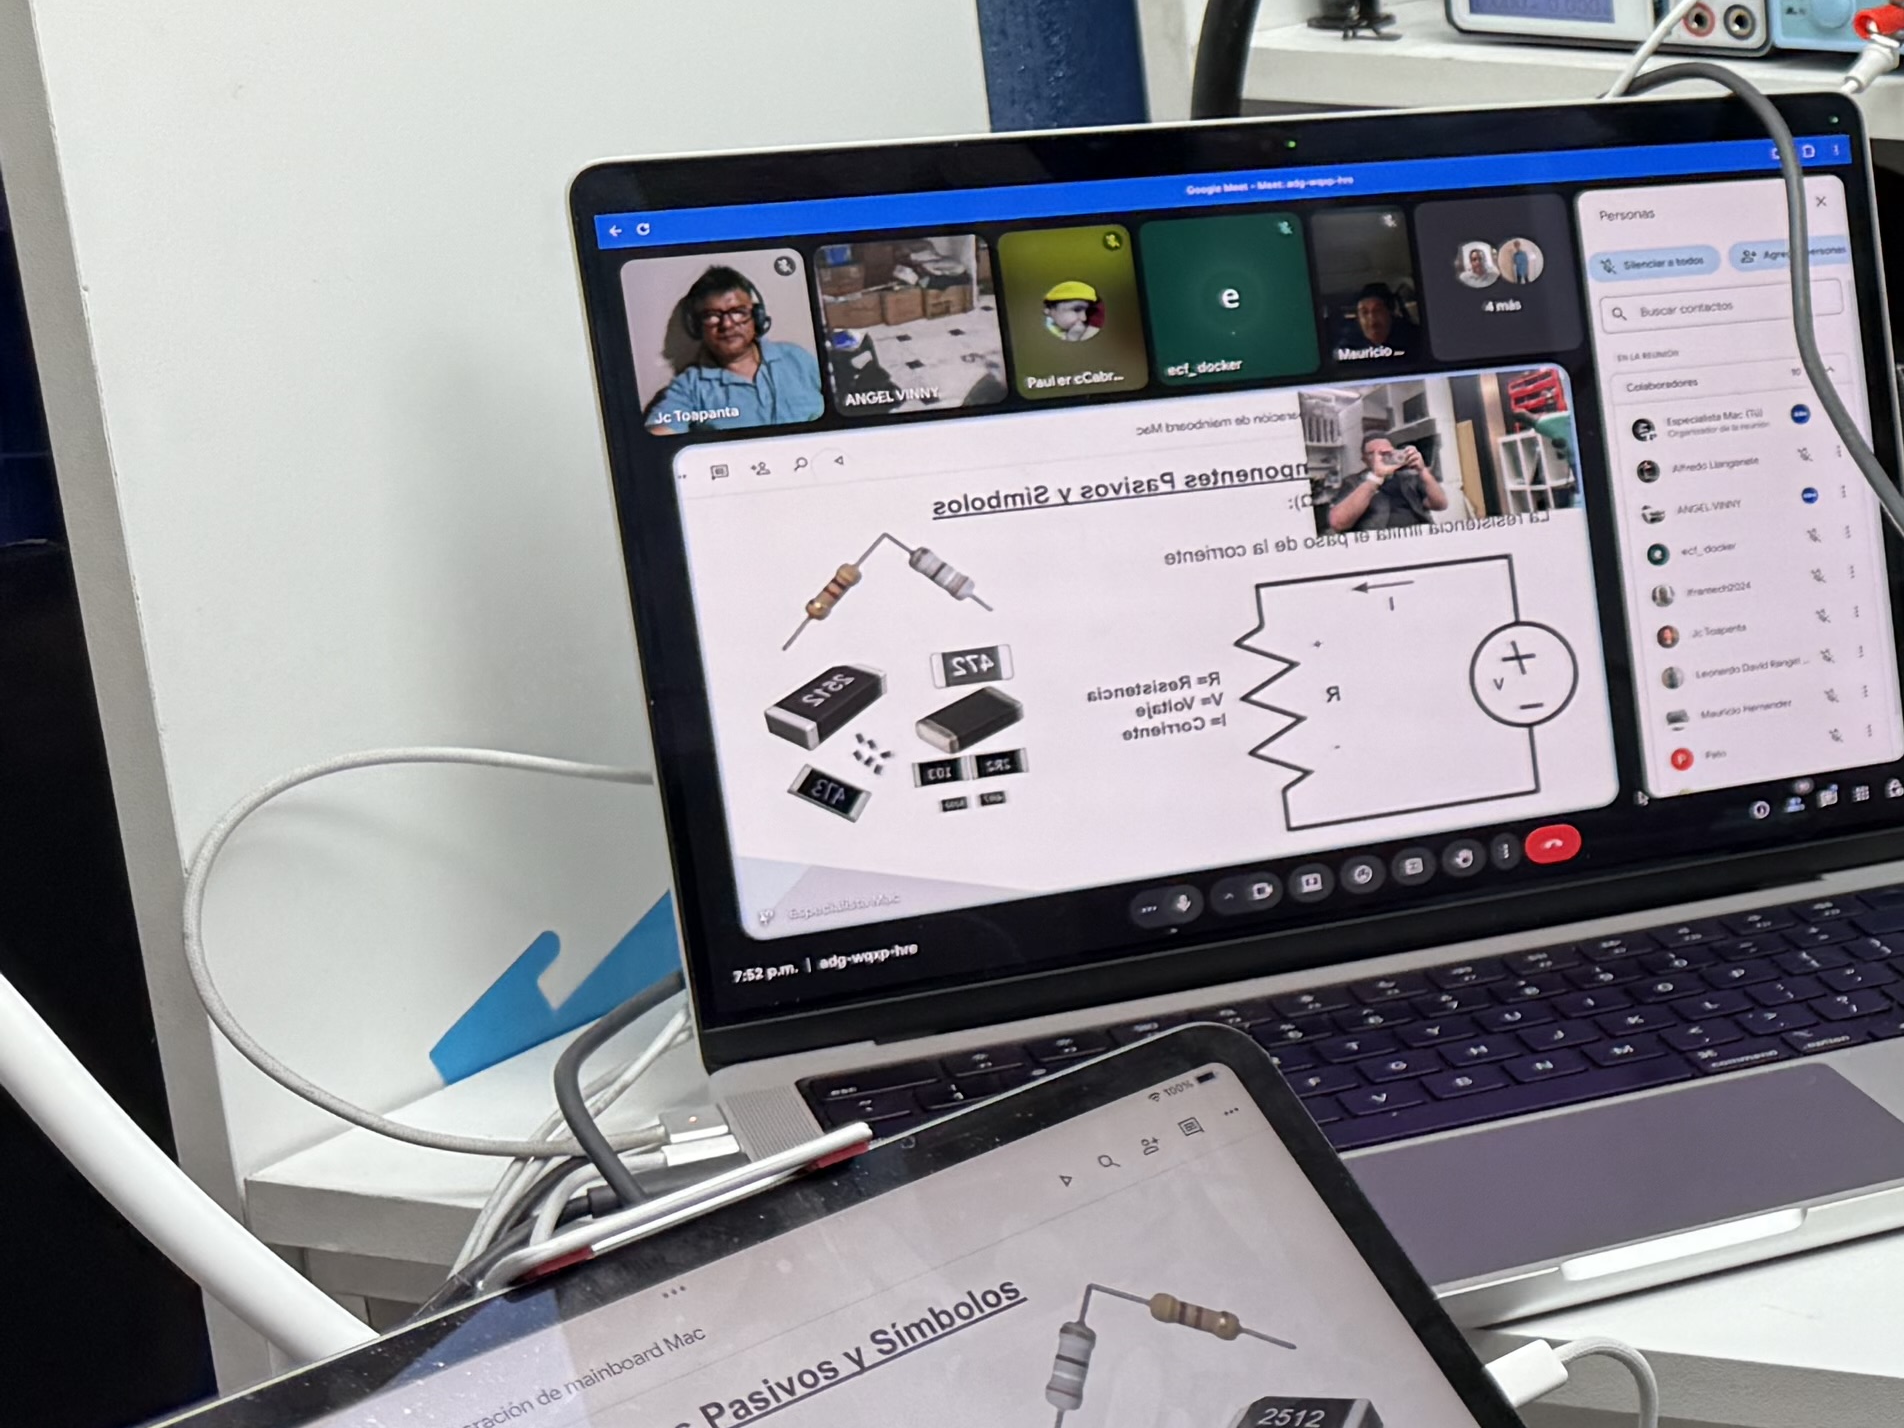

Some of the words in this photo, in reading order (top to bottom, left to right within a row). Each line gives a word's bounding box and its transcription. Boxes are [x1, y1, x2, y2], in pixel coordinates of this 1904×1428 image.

[1186, 184, 1221, 196] Google
[1223, 182, 1248, 193] Meet
[1600, 209, 1655, 221] Personas
[1624, 258, 1665, 270] Silenciar
[1676, 256, 1704, 266] todos
[1221, 288, 1240, 309] e
[1484, 301, 1494, 312] 4
[1496, 299, 1522, 312] más
[1640, 306, 1676, 318] Buscar
[1680, 301, 1733, 315] contactos
[1338, 346, 1392, 361] Mauricio
[1027, 373, 1054, 389] Paul
[1626, 378, 1698, 392] Colaboradores
[845, 389, 894, 407] ANGEL
[897, 384, 939, 402] VINNY
[655, 411, 674, 424] Jc
[678, 405, 740, 424] Toapanta
[1677, 504, 1711, 516] ANGEL
[733, 970, 764, 983] 7:52
[766, 964, 799, 981] p.m.
[1164, 1079, 1195, 1097] 100%
[843, 1348, 866, 1371] y
[869, 1279, 1022, 1357] Símbolos
[537, 1384, 561, 1406] de
[564, 1341, 664, 1397] mainboard
[665, 1327, 705, 1355] Mac
